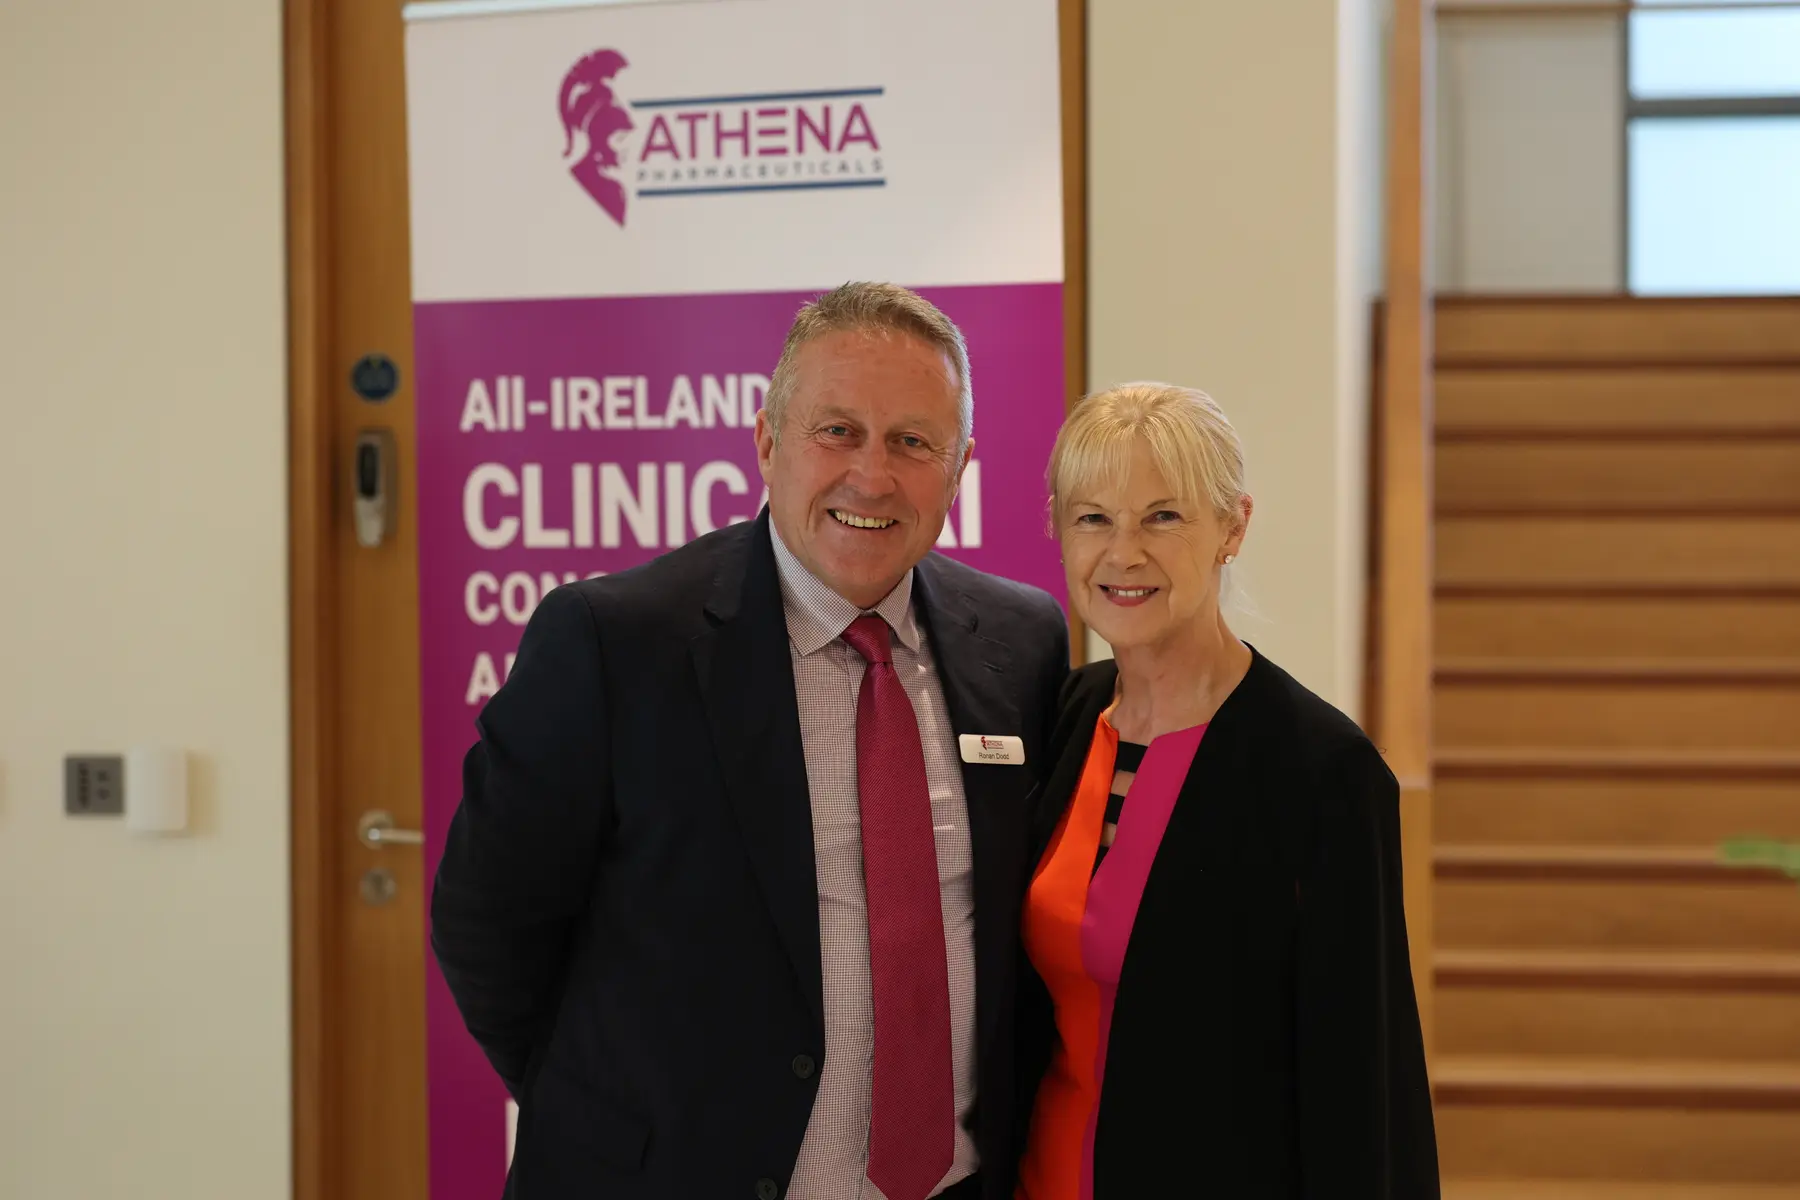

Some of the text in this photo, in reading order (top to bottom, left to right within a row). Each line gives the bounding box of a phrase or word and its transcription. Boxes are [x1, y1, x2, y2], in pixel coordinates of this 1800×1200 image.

[640, 102, 880, 163] ATHENA
[636, 157, 885, 182] PHARMACEUTICALS
[463, 460, 770, 550] CLINIC
[465, 652, 518, 705] A
